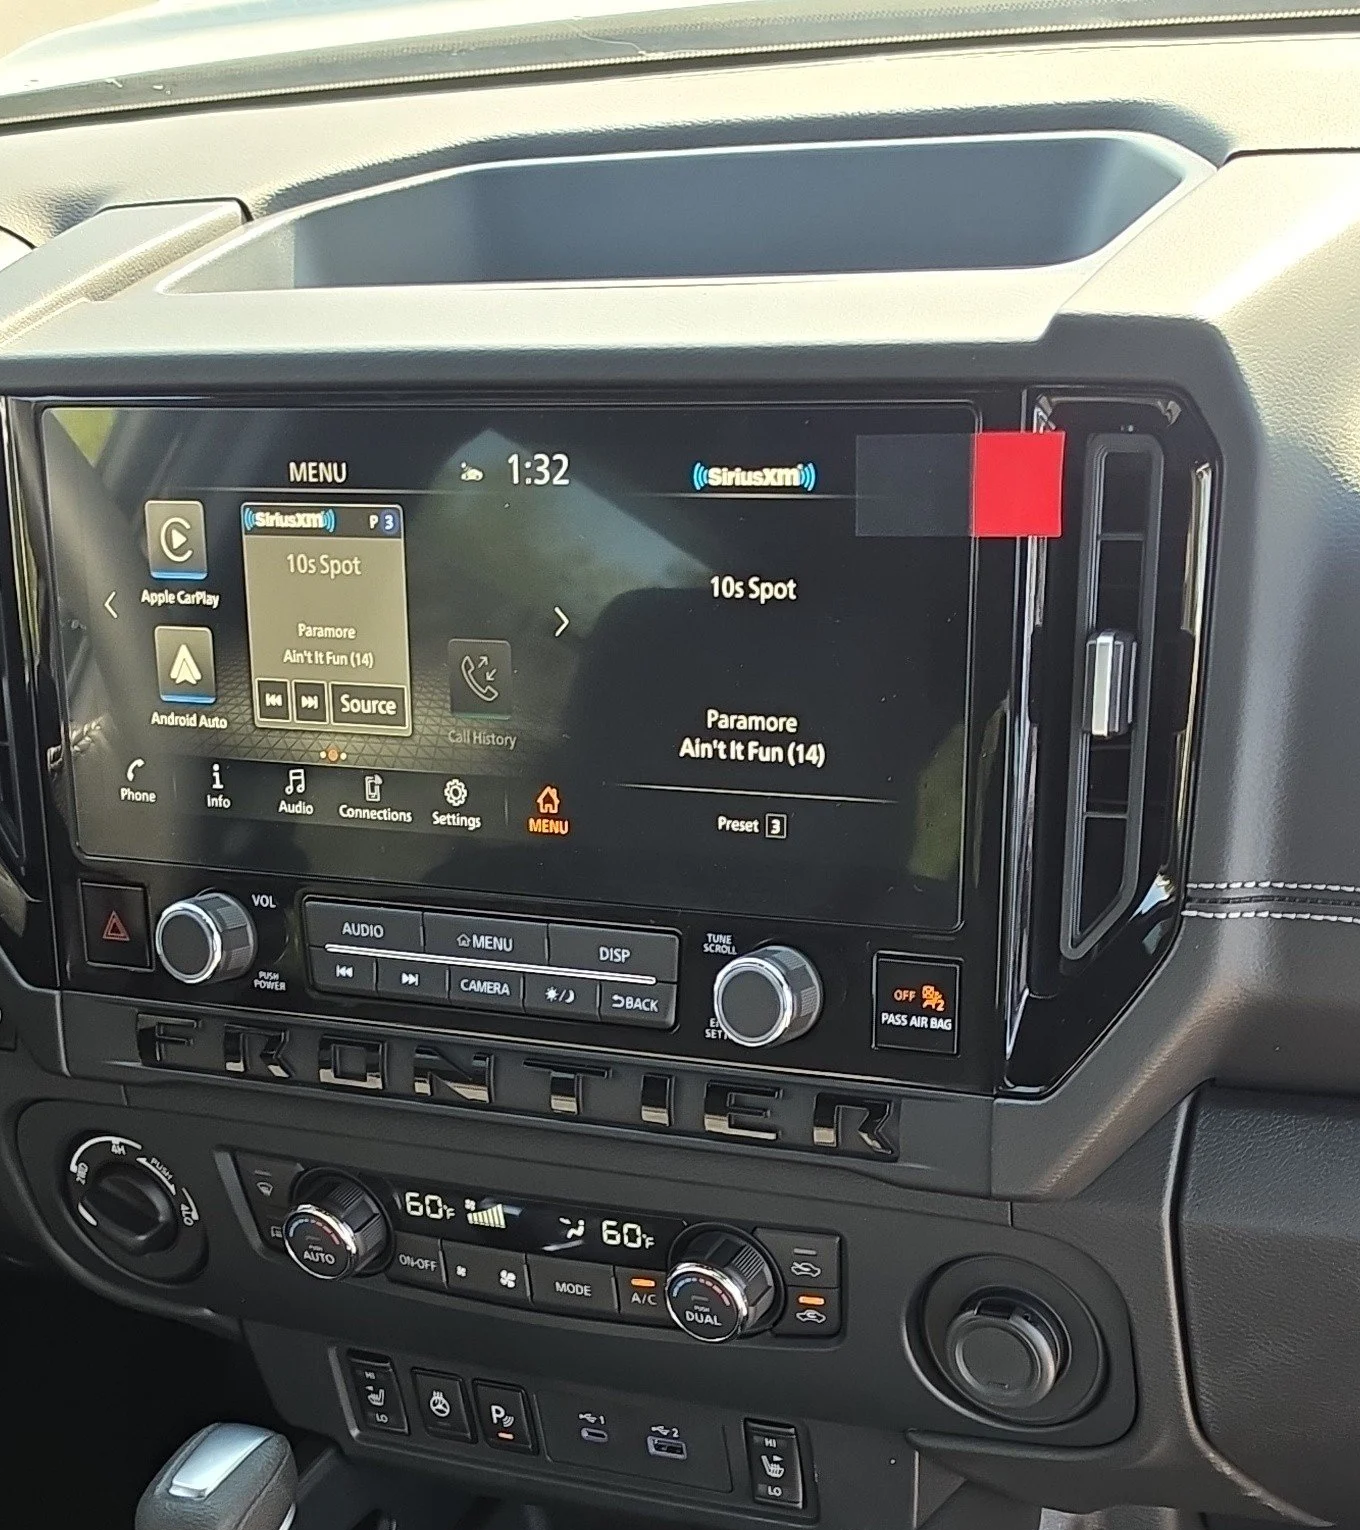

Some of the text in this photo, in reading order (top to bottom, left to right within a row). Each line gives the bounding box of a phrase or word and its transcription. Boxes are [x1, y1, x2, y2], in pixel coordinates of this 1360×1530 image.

[289, 461, 347, 483] MENU
[507, 453, 570, 487] 1:32
[369, 514, 394, 530] P 3
[287, 554, 362, 579] 10s Spot
[141, 589, 220, 609] Apple CarPlay
[710, 576, 797, 604] 10s Spot
[297, 623, 357, 640] Paramore
[282, 649, 374, 669] Ain't It Fun (14)
[340, 694, 397, 715] Source
[150, 711, 228, 729] Android Auto
[706, 708, 799, 733] Paramore
[448, 730, 517, 750] Call History
[678, 737, 826, 769] Ain't It Fun (14)
[120, 788, 156, 803] Phone
[206, 794, 231, 809] Info
[278, 800, 314, 815] Audio
[338, 804, 414, 824] Connections
[431, 811, 482, 831] Settings
[528, 817, 569, 835] MENU
[717, 815, 760, 833] Preset
[251, 893, 277, 909] VOL
[341, 921, 384, 938] AUDIO
[706, 932, 732, 945] TUNE
[472, 934, 513, 952] MENU
[702, 943, 738, 955] SCROLL
[599, 946, 631, 964] DISP
[258, 970, 280, 980] PUSH
[253, 978, 286, 991] POWER
[460, 978, 511, 997] CAMERA
[625, 996, 659, 1012] BACK
[893, 988, 917, 1003] OFF
[881, 1012, 953, 1031] PASS AIR BAG
[137, 1012, 901, 1162] FRONTIER
[303, 1250, 336, 1265] AUTO
[555, 1280, 592, 1297] MODE
[630, 1292, 658, 1306] A/C
[685, 1310, 722, 1327] DUAL
